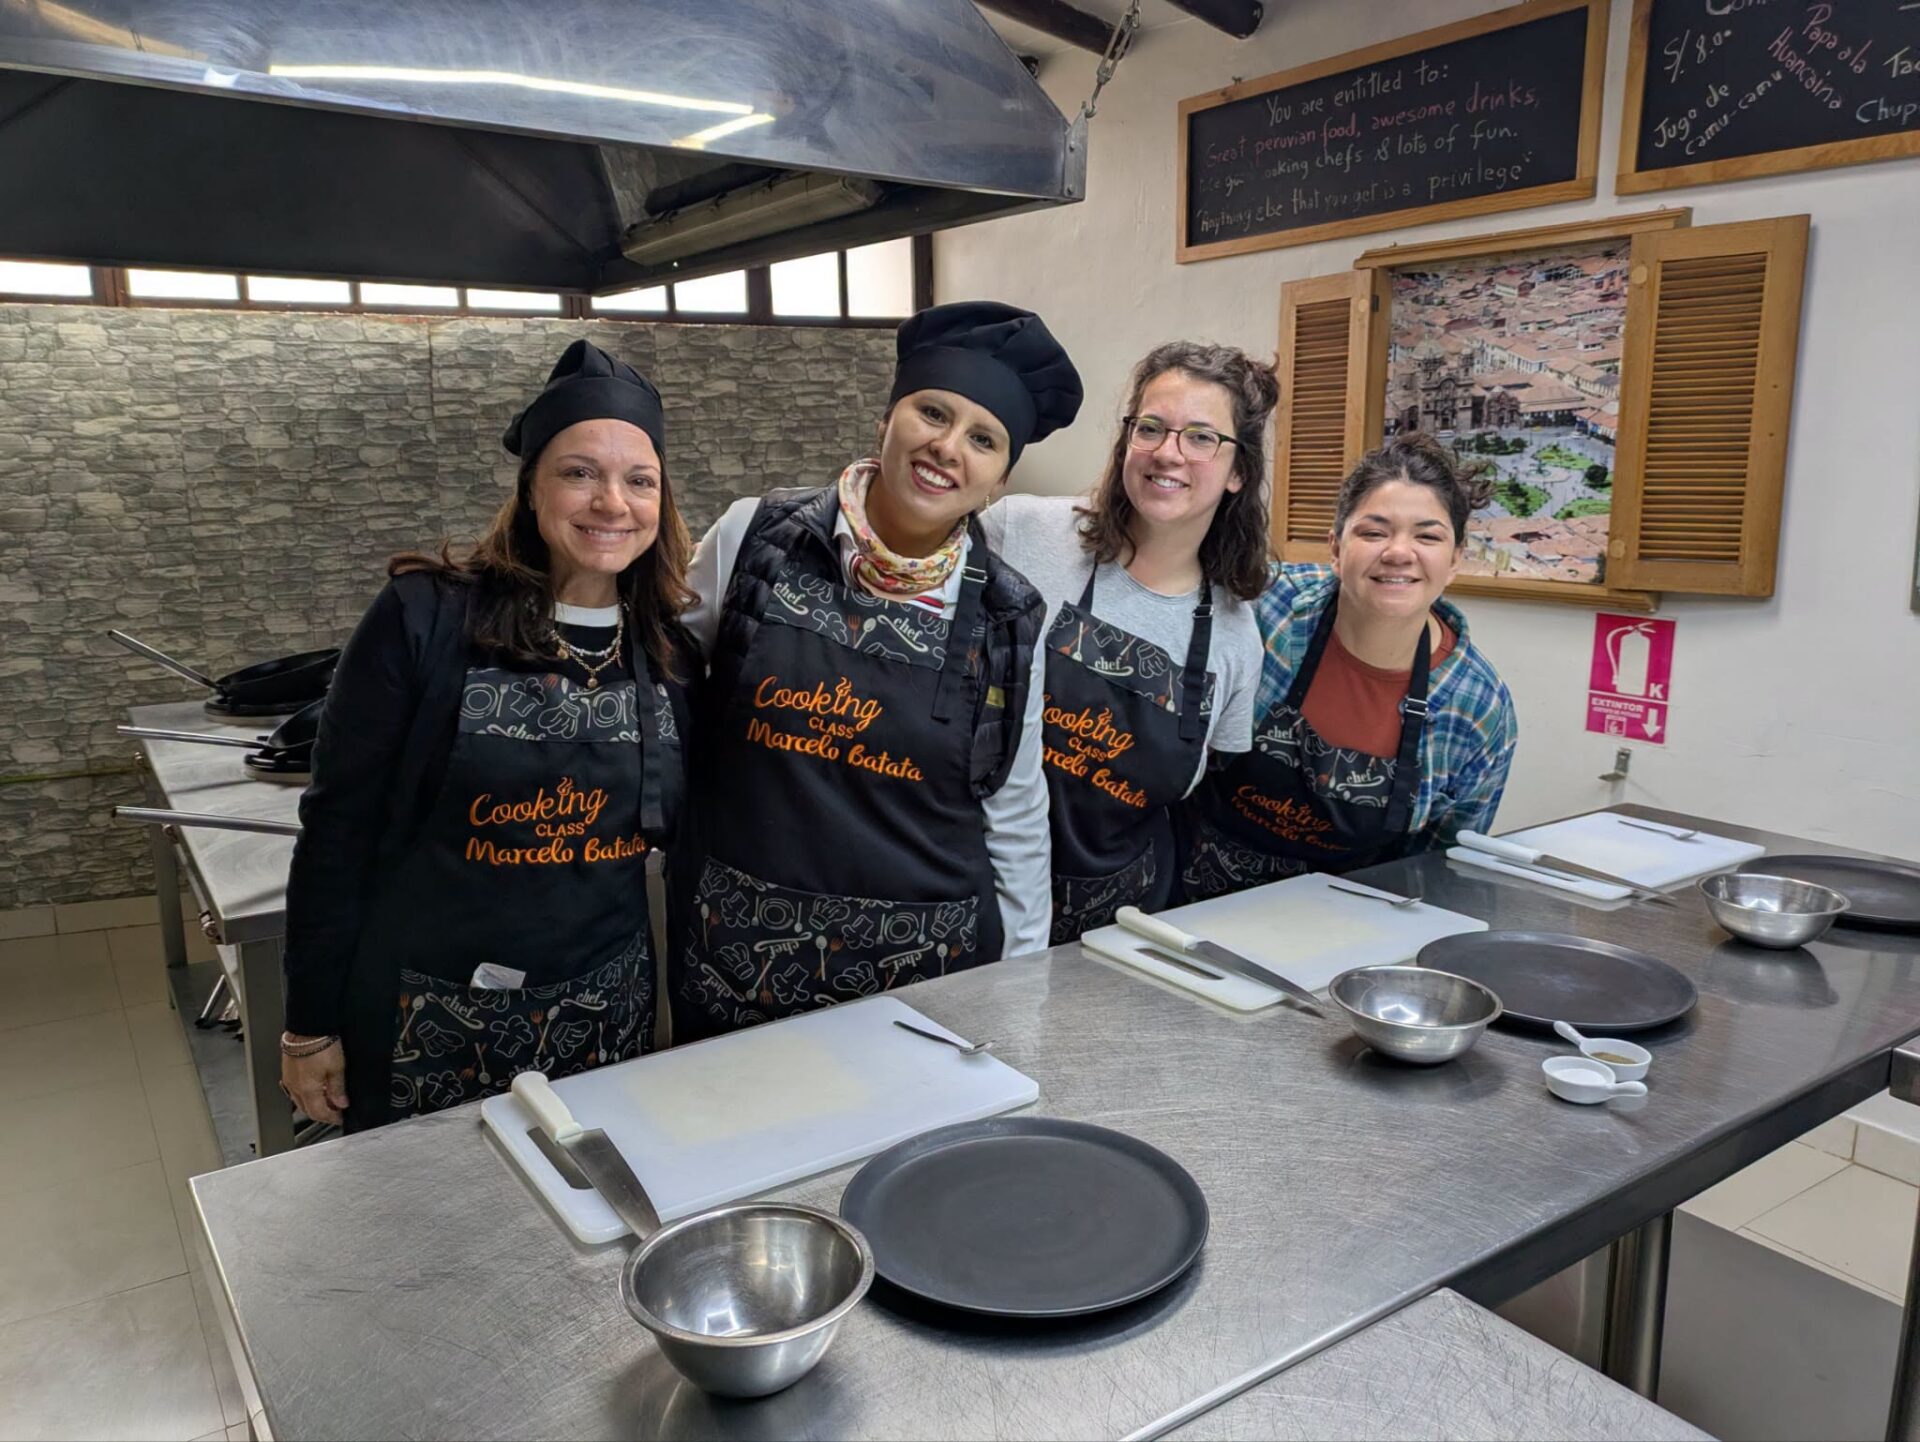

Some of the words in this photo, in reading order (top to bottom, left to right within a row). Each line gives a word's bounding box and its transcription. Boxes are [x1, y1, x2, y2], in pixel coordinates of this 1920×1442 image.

[1802, 3, 1838, 54] Papa
[1266, 95, 1291, 127] You
[1302, 98, 1324, 115] are
[1334, 70, 1401, 107] entitled
[1414, 59, 1449, 86] to:
[1654, 109, 1697, 148] Jugo
[1706, 84, 1730, 108] de
[1255, 131, 1316, 167] peruvian
[1372, 100, 1456, 130] awesome
[1316, 143, 1363, 173] chefs
[1397, 132, 1428, 155] lots
[1434, 123, 1460, 153] of
[1293, 188, 1320, 214] that
[1384, 179, 1396, 199] is
[1402, 183, 1411, 196] a
[772, 581, 807, 606] chef
[893, 617, 923, 642] chef
[1094, 655, 1122, 671] chef
[1649, 683, 1664, 699] K
[754, 676, 882, 732] Cooking
[1591, 697, 1645, 713] EXTINTOR
[808, 716, 855, 740] CLASS
[1043, 695, 1134, 759] ooking
[1267, 726, 1294, 739] chef
[747, 718, 840, 760] Marcelo
[848, 744, 924, 781] Batata
[1068, 736, 1107, 762] CLASS
[1043, 746, 1088, 777] rcelo
[1092, 768, 1149, 808] Batata
[1346, 770, 1372, 783] chef
[469, 776, 609, 825] Cooking
[535, 823, 586, 838] CLASS
[465, 837, 574, 866] Marcelo
[584, 833, 648, 864] Batata
[769, 941, 800, 960] chef
[893, 951, 922, 974] chef
[442, 994, 479, 1019] chef
[575, 988, 604, 1004] chef
